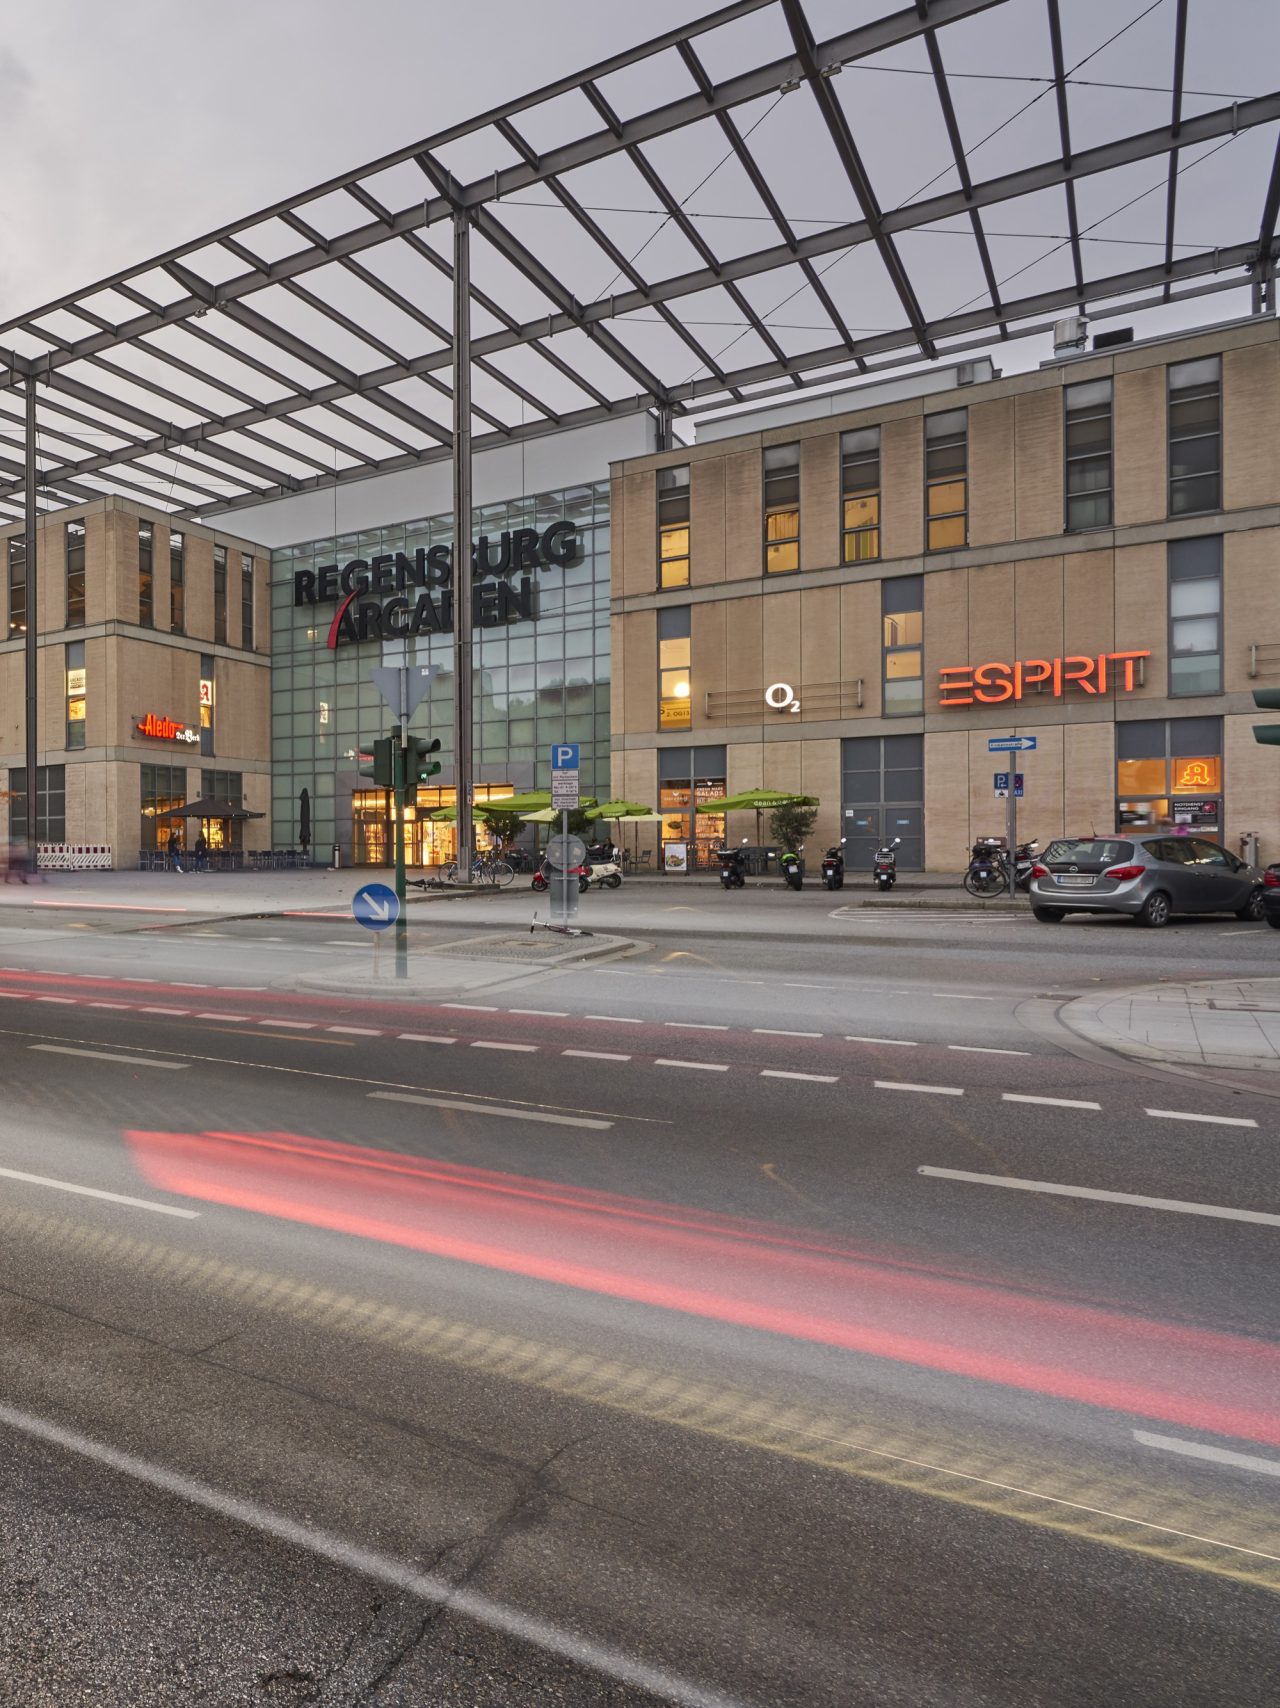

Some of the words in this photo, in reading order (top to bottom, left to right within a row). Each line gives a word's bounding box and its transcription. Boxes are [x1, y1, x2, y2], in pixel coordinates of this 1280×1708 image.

[294, 520, 578, 607] REGENSURG
[939, 650, 1152, 704] ESPRIT
[138, 713, 184, 739] Aledo
[557, 747, 573, 767] P
